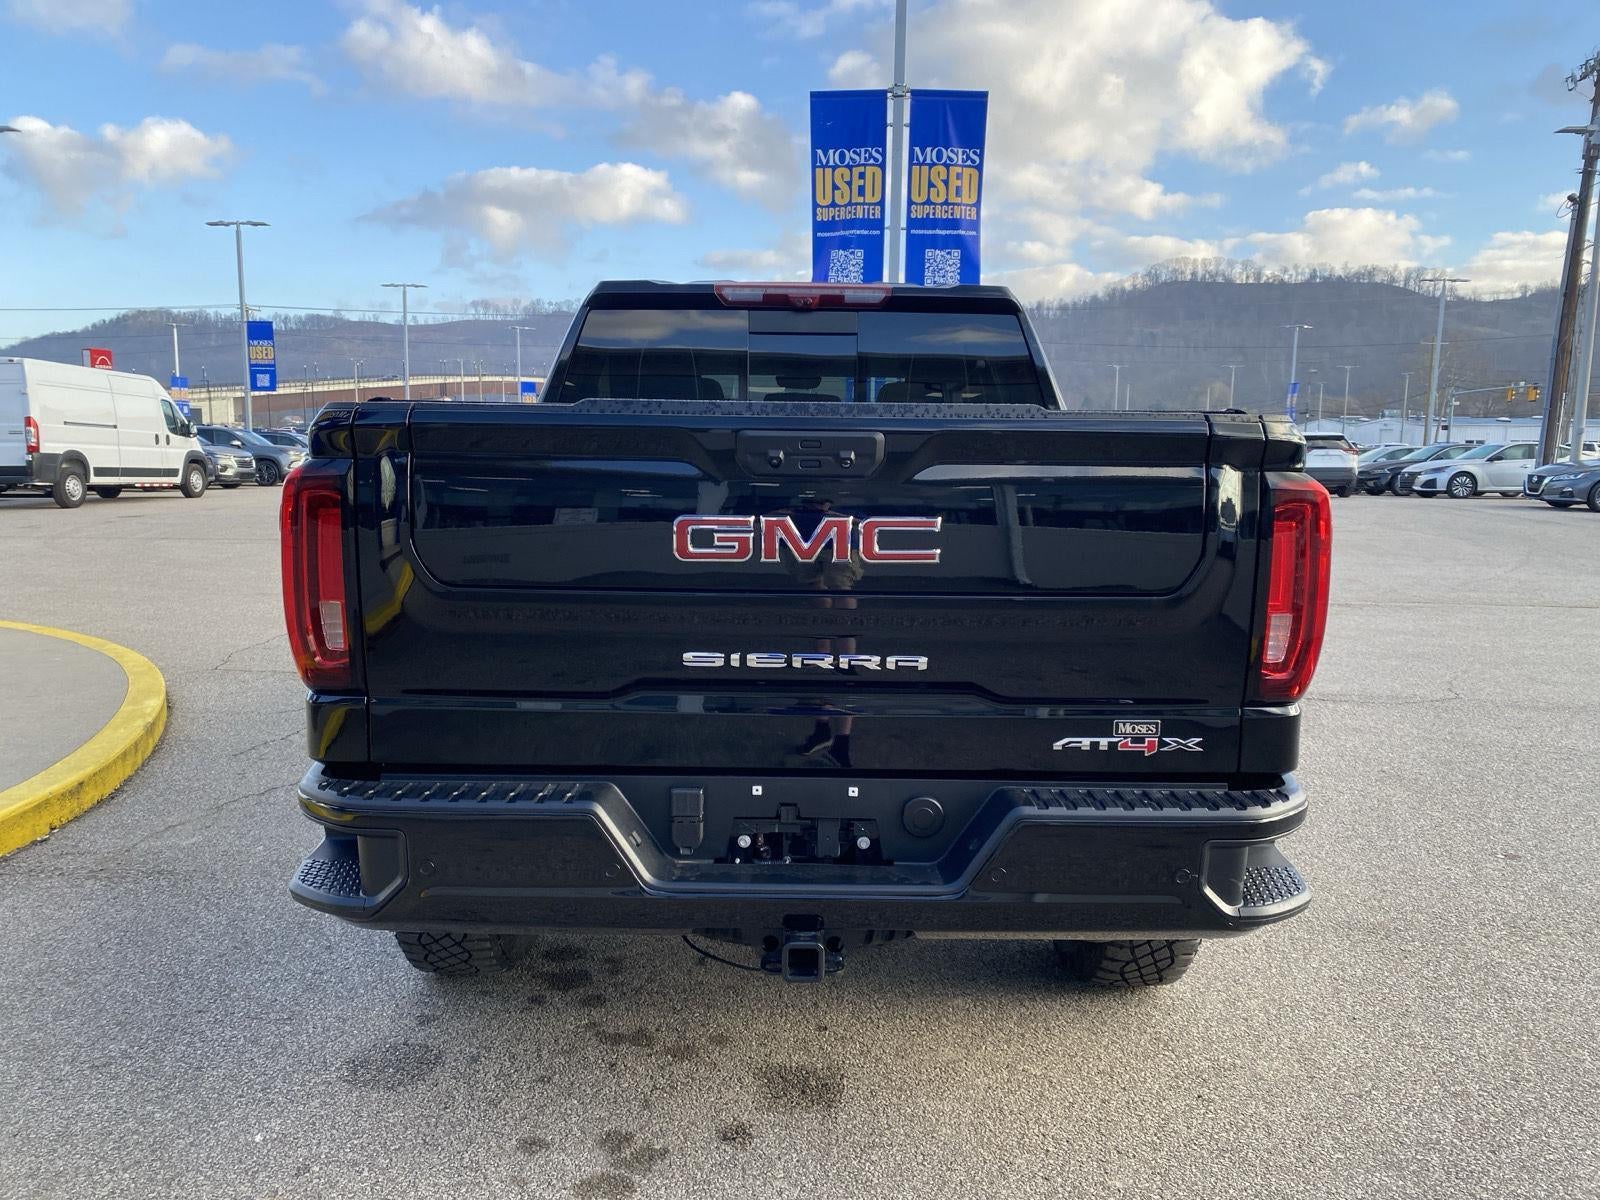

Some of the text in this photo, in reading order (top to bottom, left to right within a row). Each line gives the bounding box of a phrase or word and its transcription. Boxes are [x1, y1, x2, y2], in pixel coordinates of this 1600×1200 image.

[816, 147, 882, 166] MOSES
[912, 146, 980, 165] MOSES
[815, 166, 882, 206] USED
[911, 165, 979, 204] USED
[816, 205, 881, 221] SUPERCENTER
[910, 205, 977, 220] SUPERCENTER
[249, 346, 274, 360] USED
[673, 514, 942, 564] GMC
[682, 652, 929, 671] SIERRA
[1118, 723, 1156, 734] MOSES
[1053, 737, 1204, 757] AT4X
